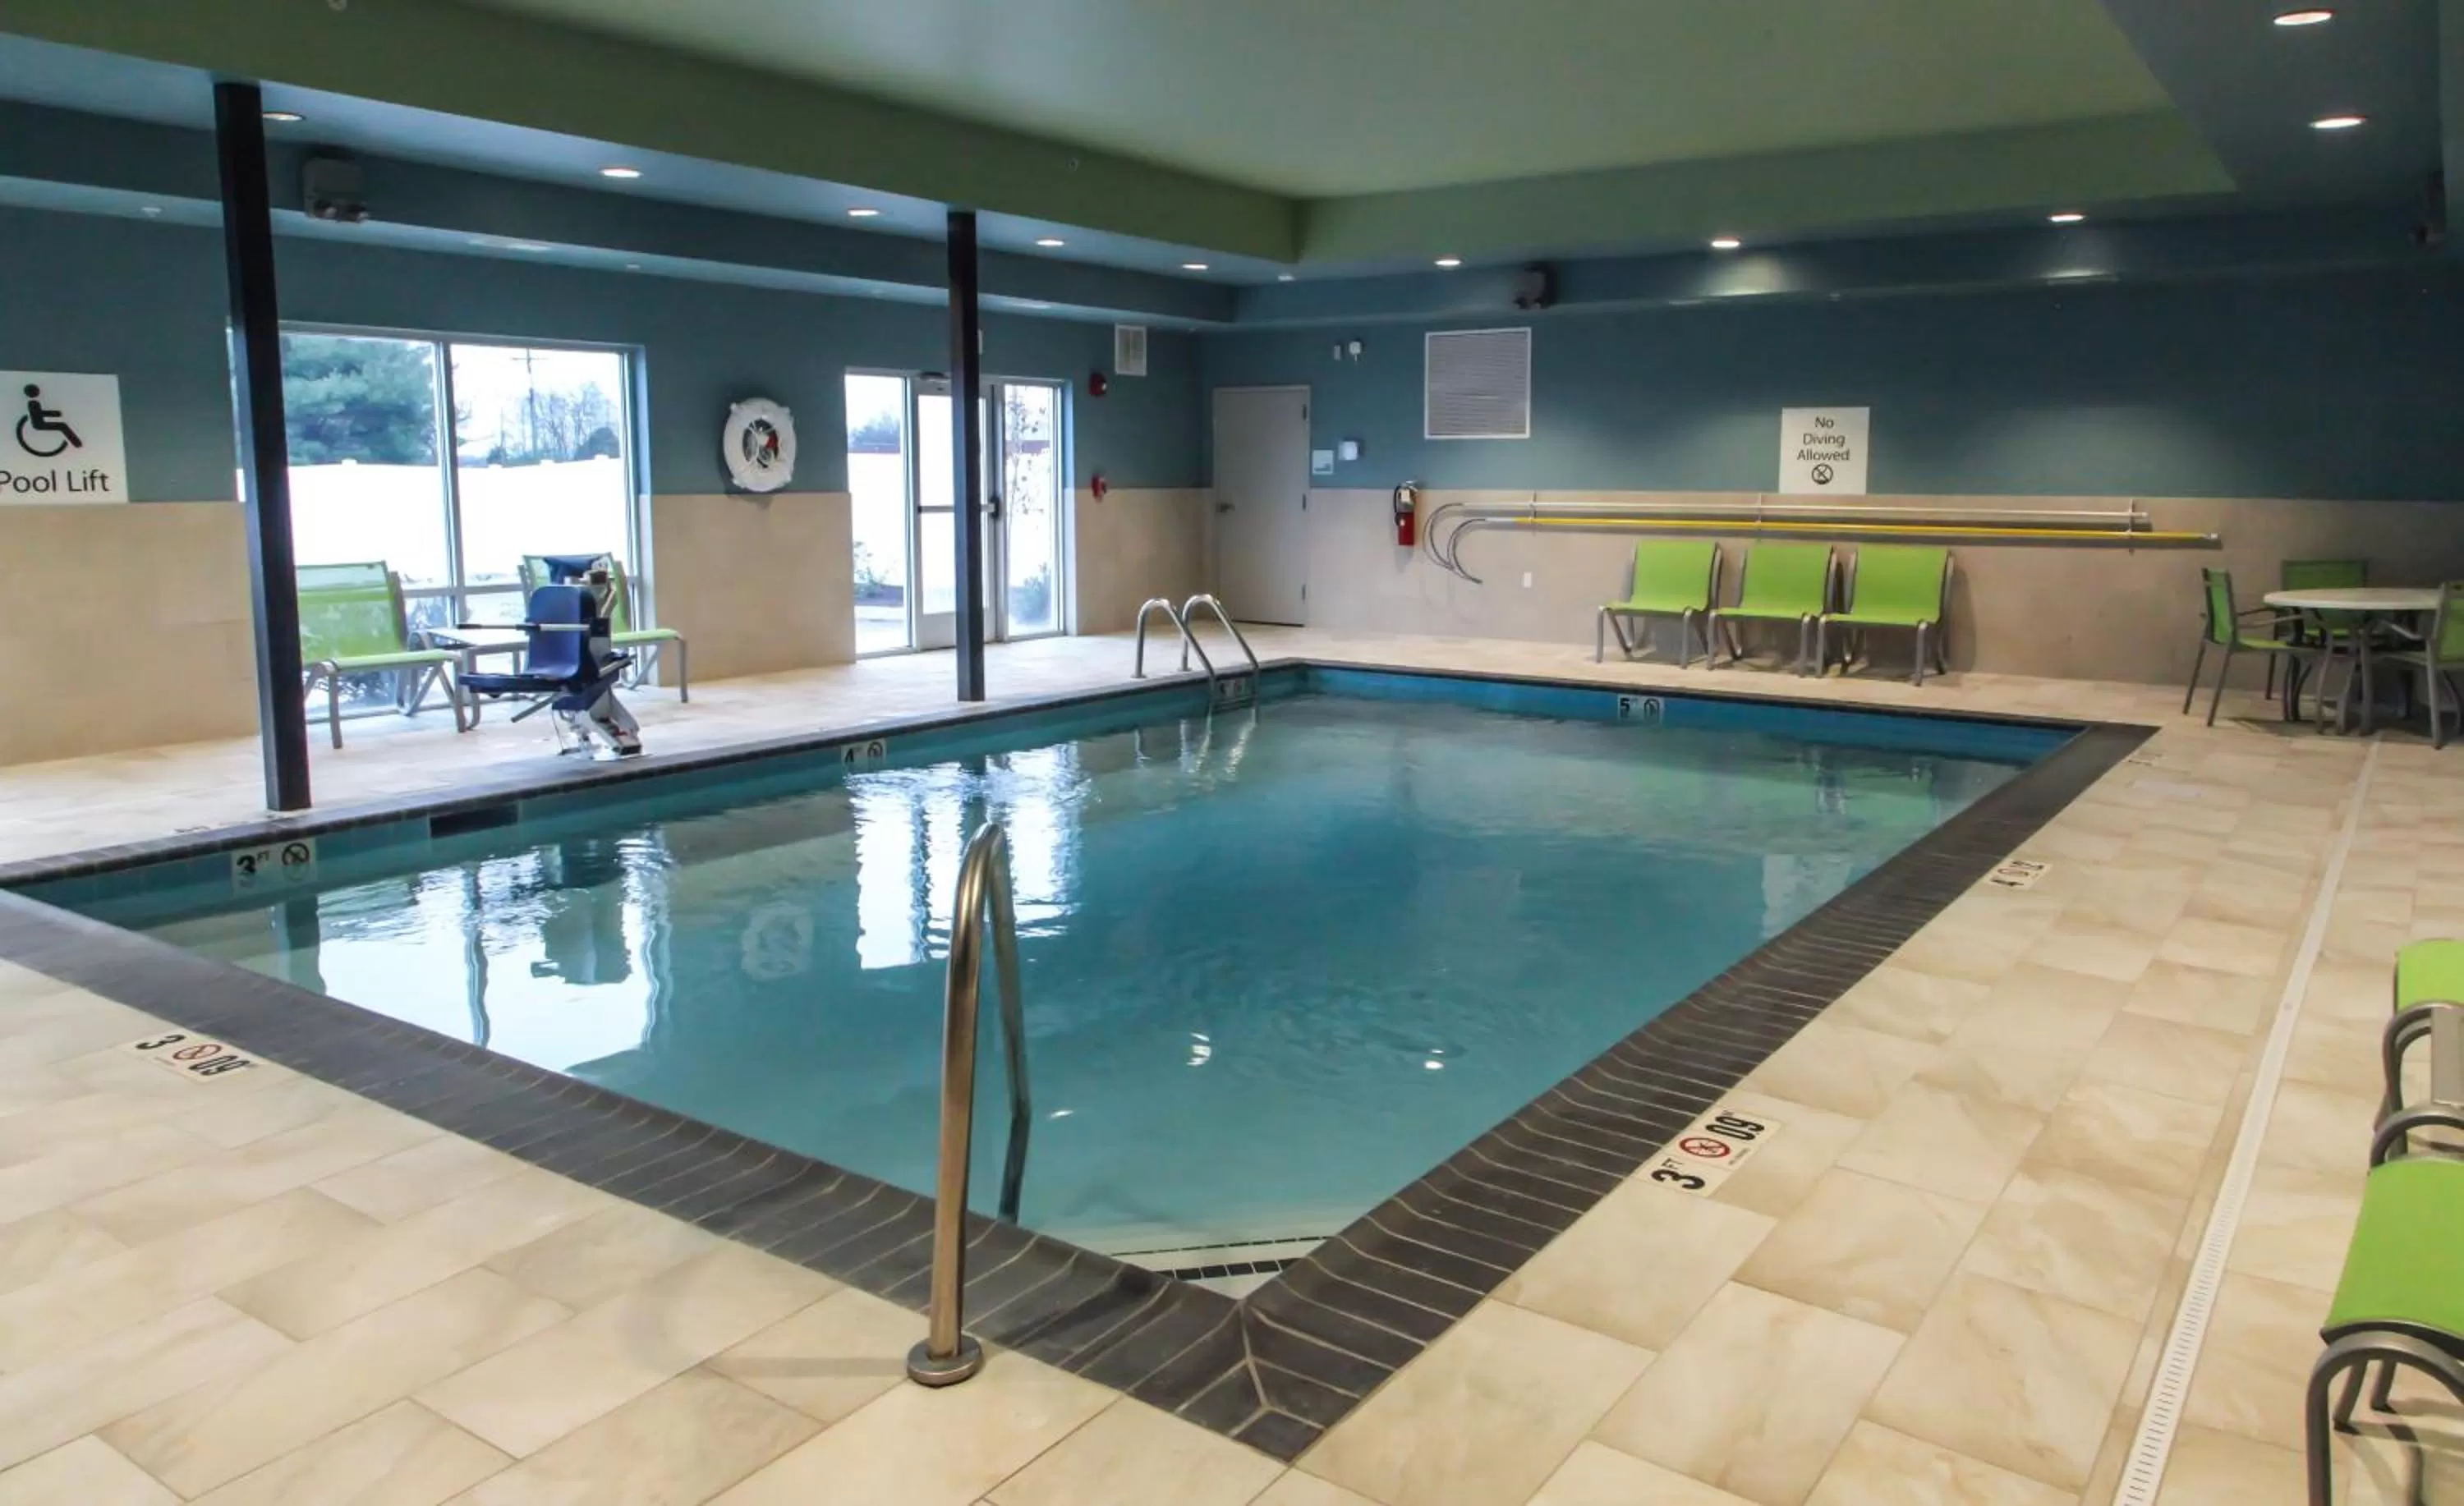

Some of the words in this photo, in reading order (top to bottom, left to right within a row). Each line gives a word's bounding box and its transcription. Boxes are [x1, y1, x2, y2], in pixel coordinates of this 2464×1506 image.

[1814, 416, 1834, 429] No
[1803, 434, 1846, 448] Diving
[1796, 448, 1850, 461] Allowed
[67, 470, 111, 492] Lift
[136, 1035, 186, 1050] 3
[1651, 1169, 1705, 1190] 3
